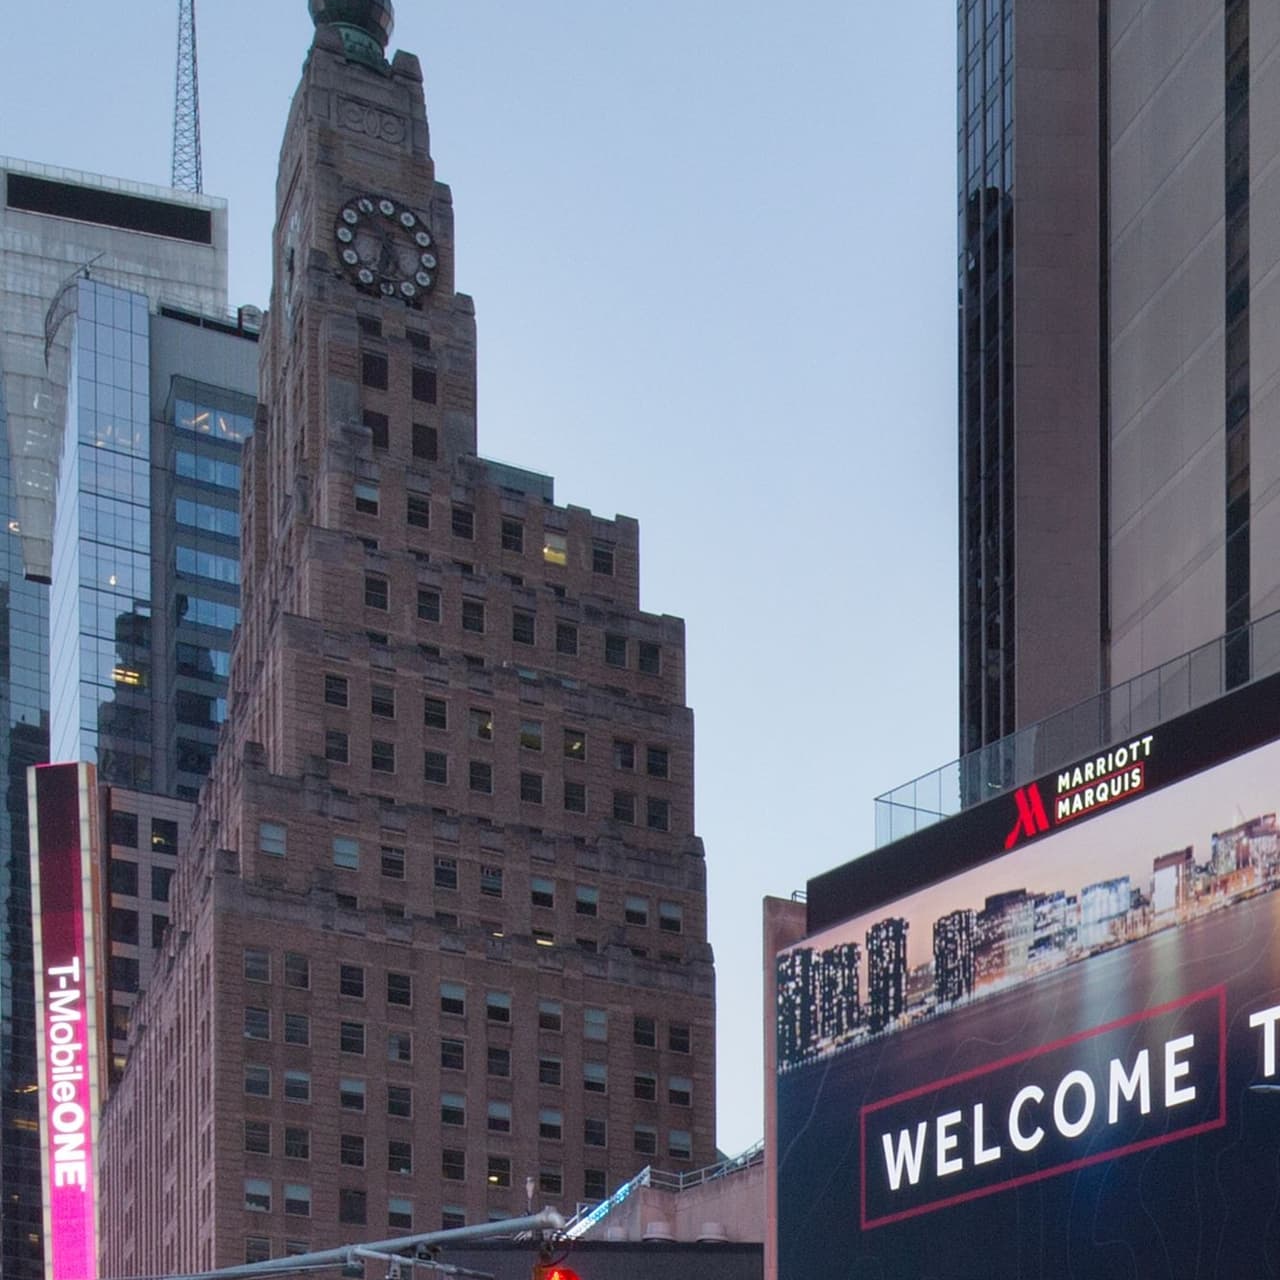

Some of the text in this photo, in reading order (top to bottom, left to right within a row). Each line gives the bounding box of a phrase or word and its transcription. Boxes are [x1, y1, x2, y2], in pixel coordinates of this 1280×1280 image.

[1057, 735, 1153, 793] MARRIOTT
[1057, 768, 1141, 819] MARQUIS
[882, 1034, 1196, 1191] WELCOME
